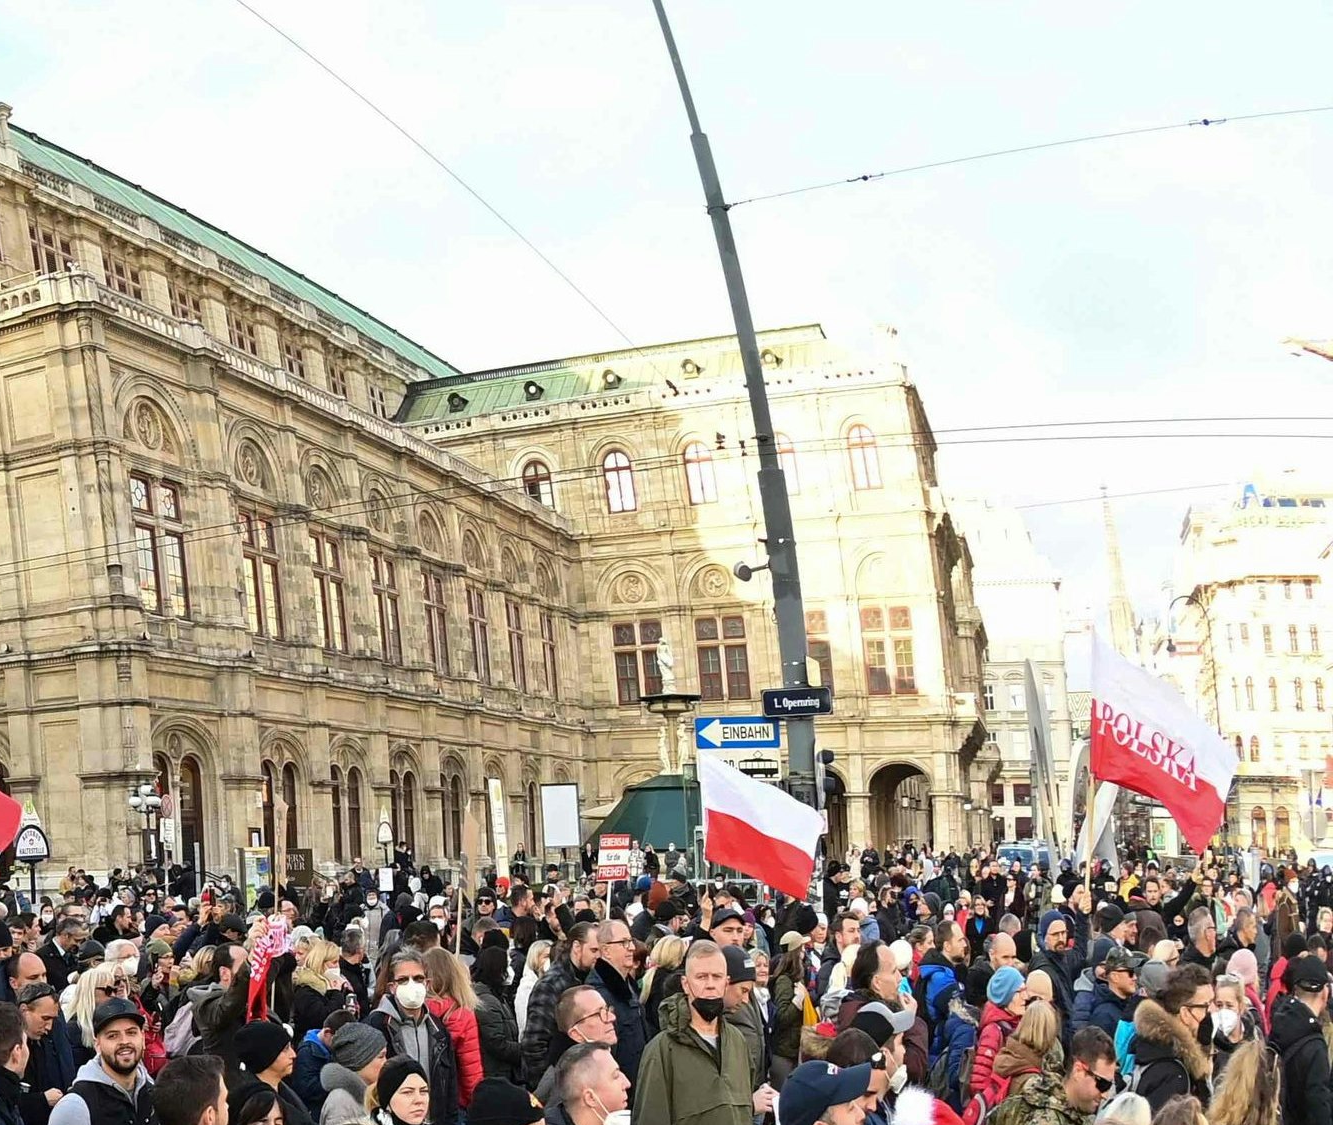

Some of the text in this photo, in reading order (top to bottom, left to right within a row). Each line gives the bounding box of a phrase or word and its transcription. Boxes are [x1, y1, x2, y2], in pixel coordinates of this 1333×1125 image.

[783, 696, 820, 710] Opernring
[722, 726, 770, 740] EINBAHN
[1097, 702, 1197, 792] POLSKA
